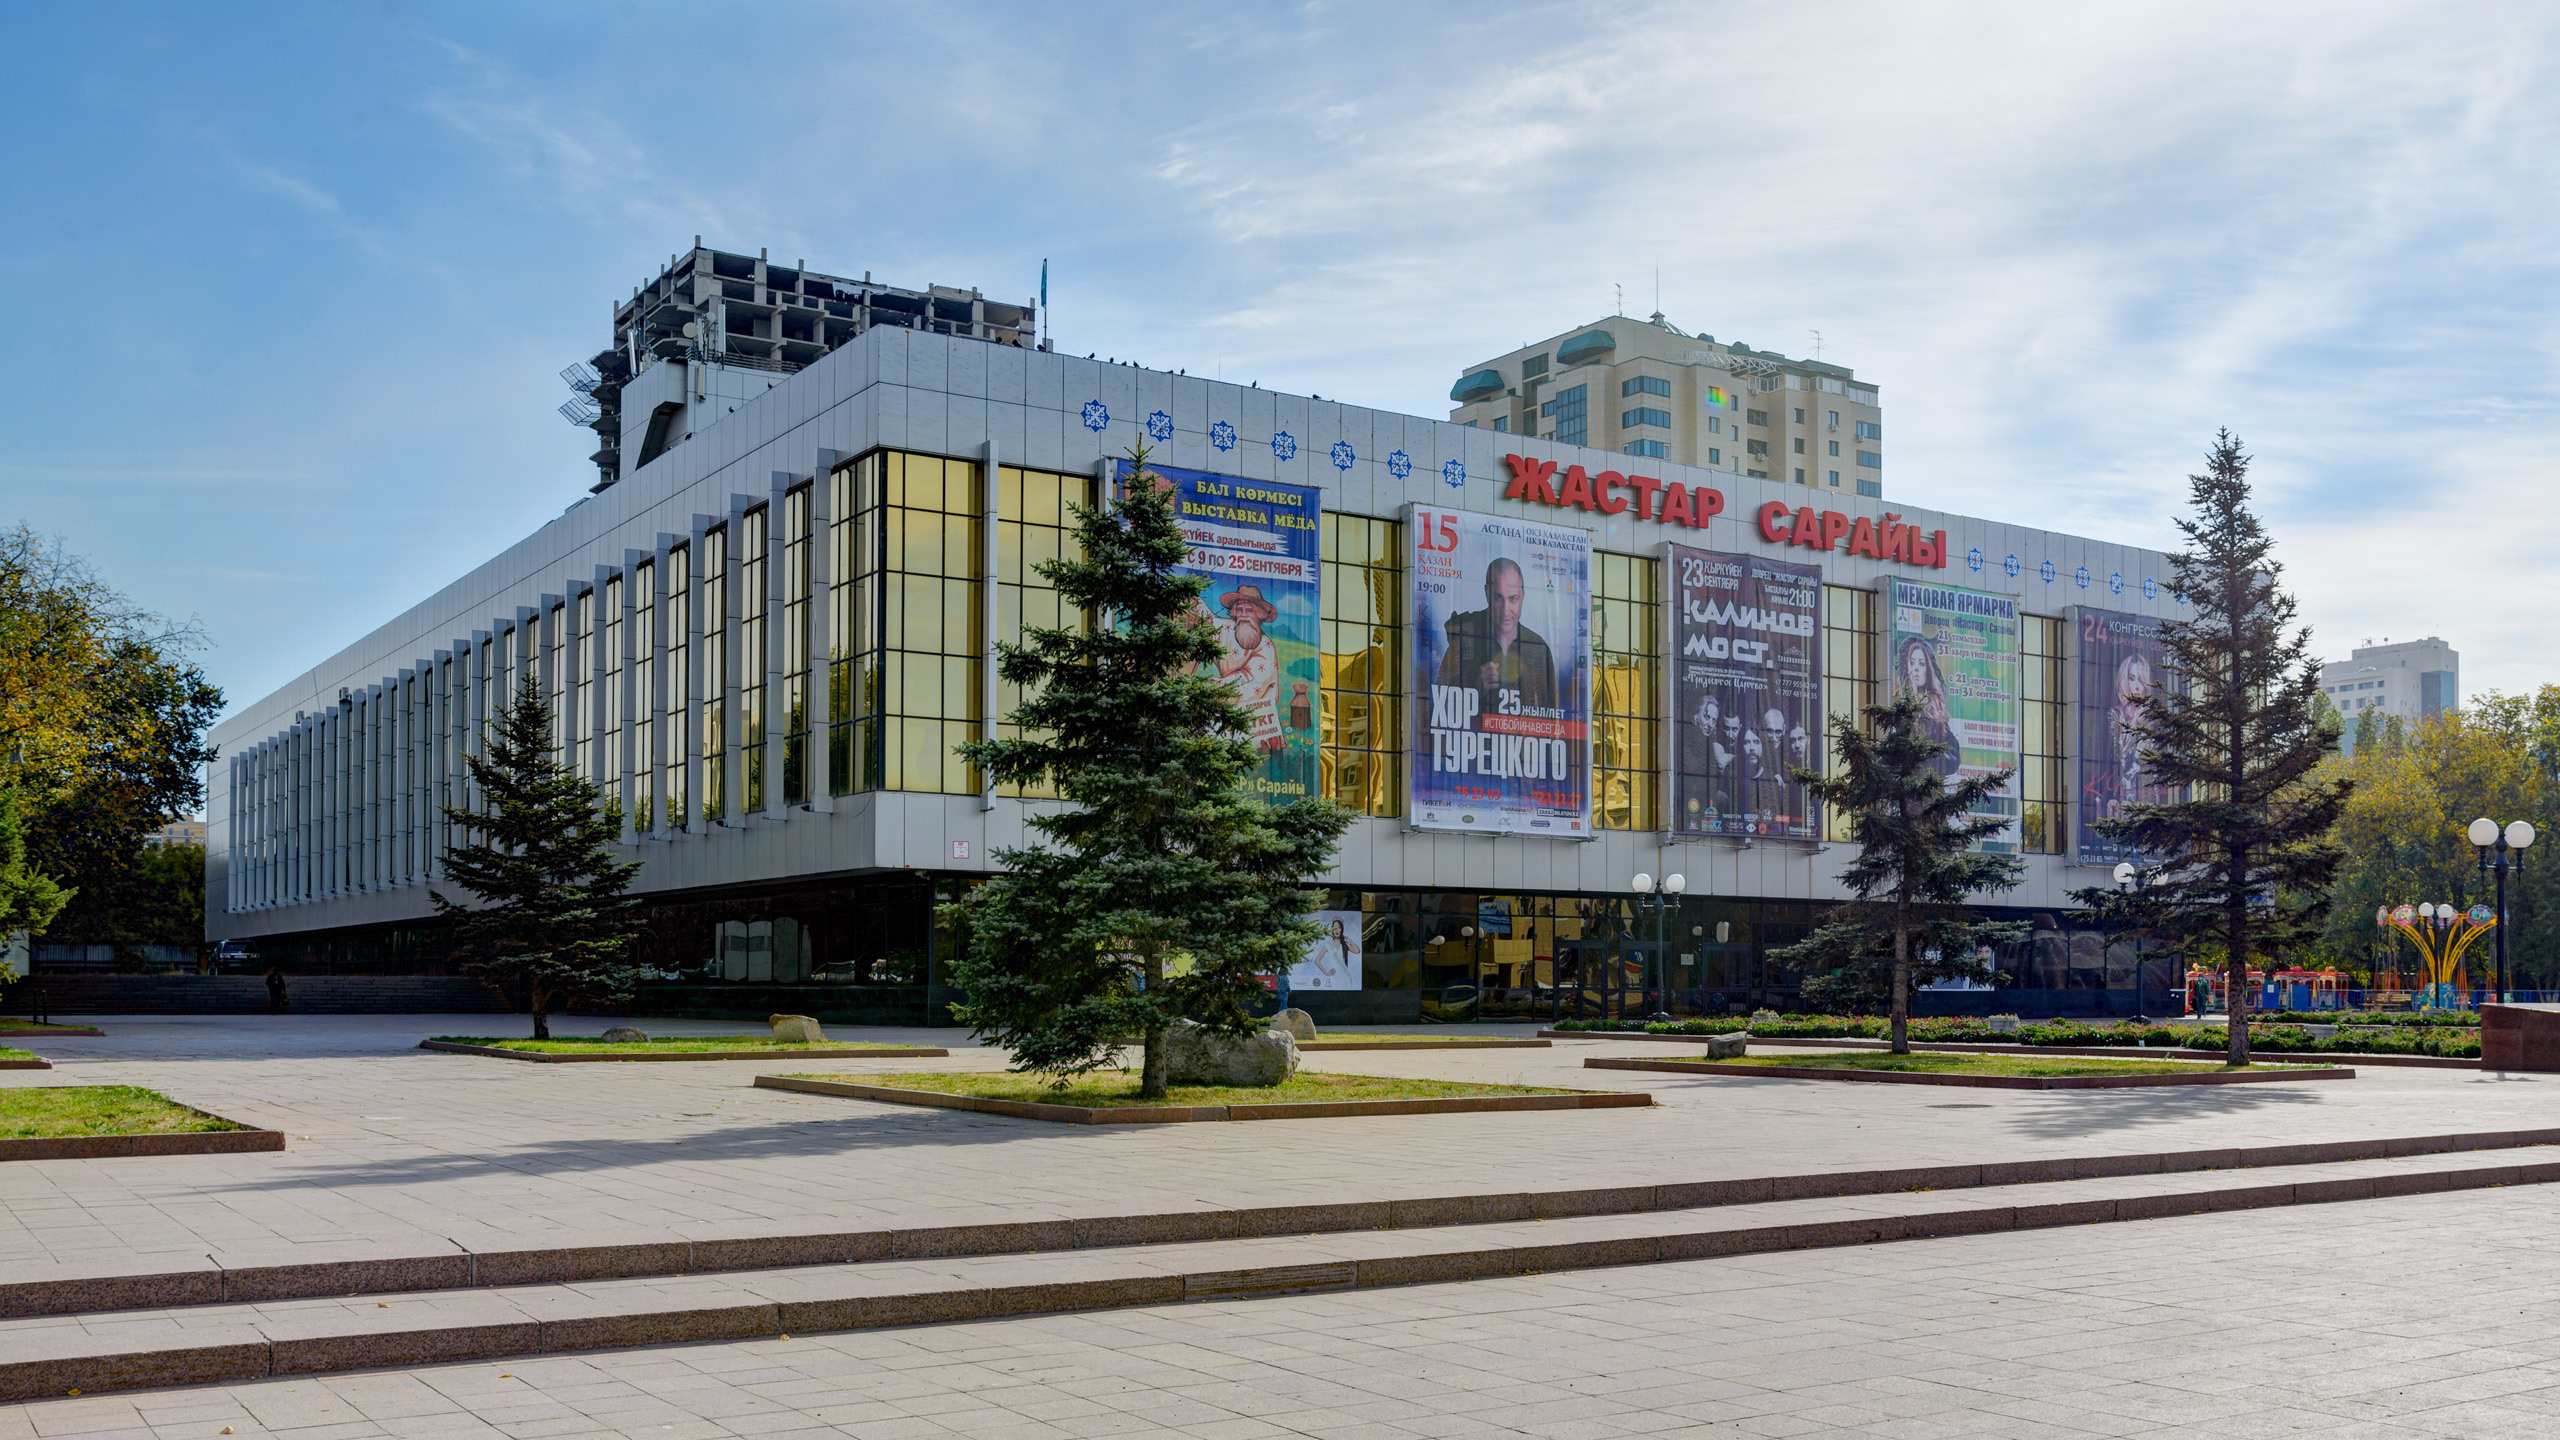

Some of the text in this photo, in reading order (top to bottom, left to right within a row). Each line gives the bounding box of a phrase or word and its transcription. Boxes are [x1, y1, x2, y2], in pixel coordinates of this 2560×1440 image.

[1196, 480, 1303, 507] БАЛ КӨРМЕСІ
[1181, 501, 1316, 531] ВЫСТАВКА МЁДА
[1505, 453, 1947, 569] ЖАСТАР САРАЙЫ
[1417, 512, 1459, 553] 15
[1481, 523, 1522, 539] АСТАНА
[1543, 539, 1586, 552] КАЗАХСТАН
[1198, 551, 1206, 564] 9
[1209, 554, 1225, 567] ПО
[1229, 554, 1245, 569] 25
[1246, 559, 1303, 577] СЕНТЯБРЯ
[1418, 553, 1452, 567] ҚАЗАН
[1418, 565, 1462, 579] ОКТЯБРЯ
[1682, 558, 1703, 587] 23
[1418, 581, 1446, 594] 19:00
[1704, 575, 1739, 591] СЕНТЯБРЯ
[1789, 588, 1815, 608] 21:00
[1897, 583, 2014, 620] МЕХОВАЯ ЯРМАРКА
[1925, 614, 1950, 628] Дворец
[2083, 614, 2108, 644] 24
[1938, 630, 1950, 640] 21
[1938, 645, 1950, 656] 31
[1956, 674, 1967, 684] 21
[1970, 677, 1999, 688] августа
[1498, 688, 1566, 720] 25 ЖЫЛ/ЛЕТ
[1962, 687, 1974, 697] 31
[1976, 690, 2012, 701] сентября
[1431, 684, 1479, 730] ХОР
[1484, 716, 1566, 736] #СТОБОЙИНАВСЕГДА
[1430, 728, 1567, 781] ТУРЕЦКОГО
[1256, 777, 1306, 797] Сарайы
